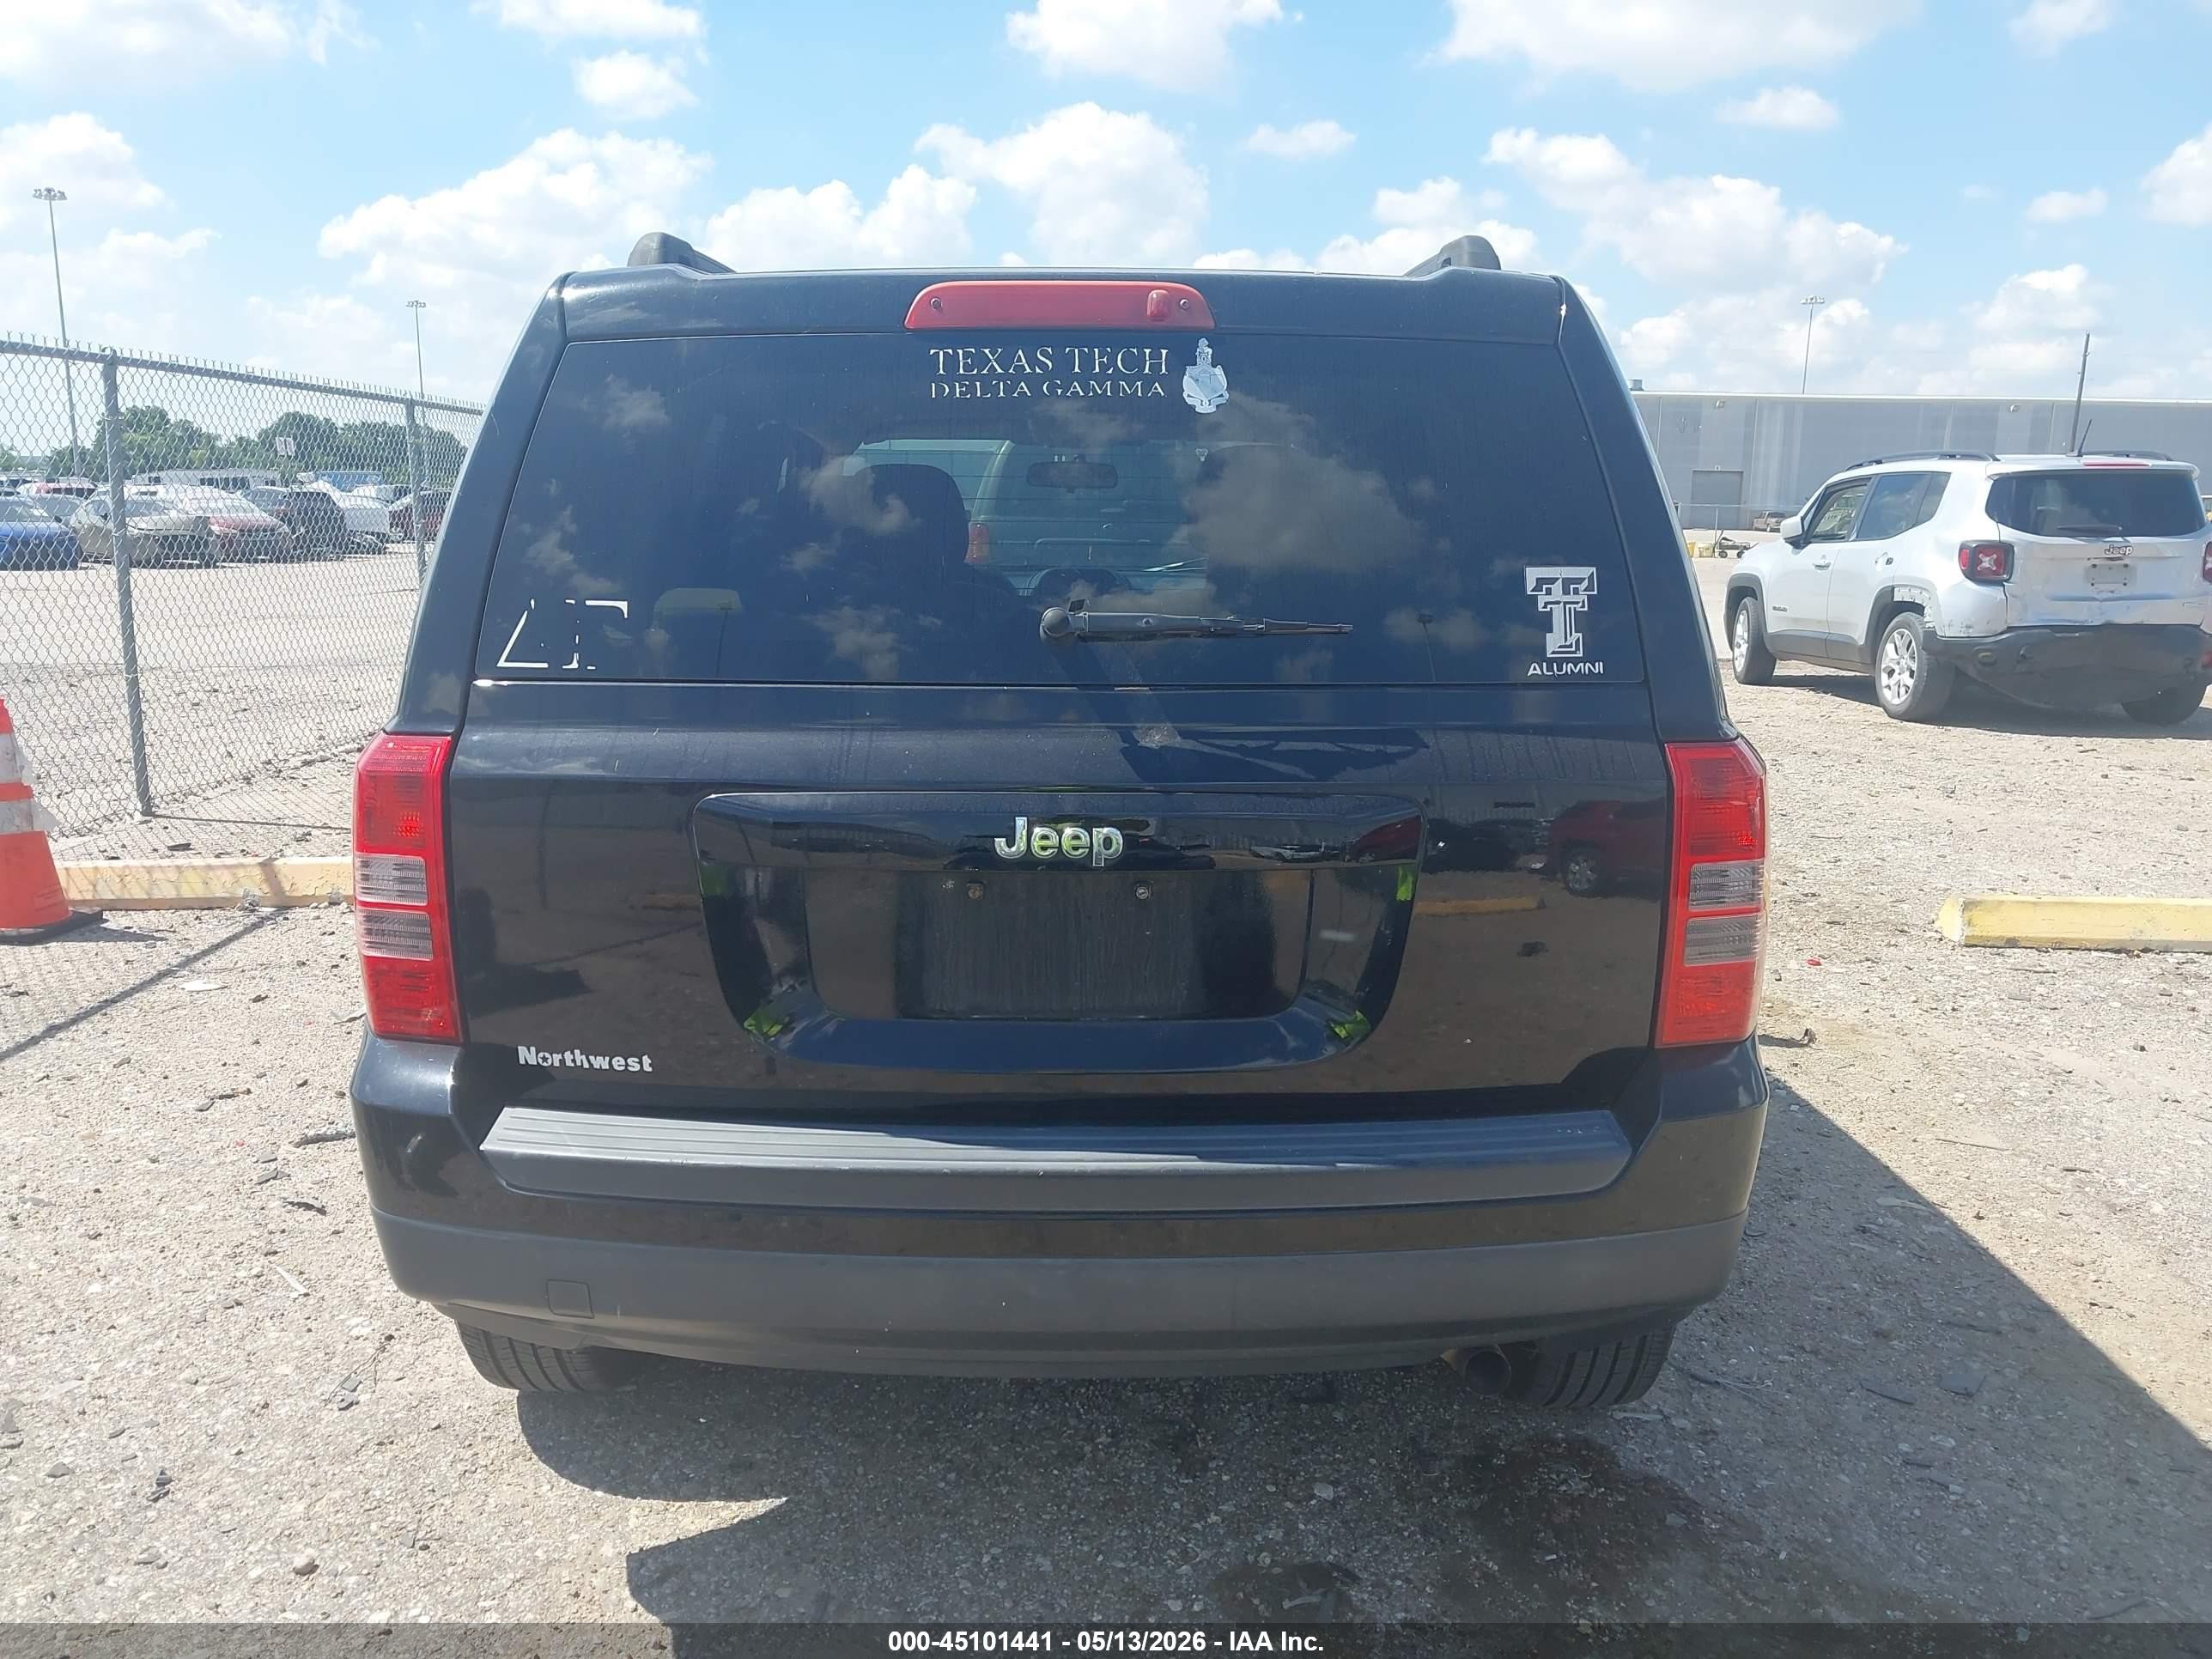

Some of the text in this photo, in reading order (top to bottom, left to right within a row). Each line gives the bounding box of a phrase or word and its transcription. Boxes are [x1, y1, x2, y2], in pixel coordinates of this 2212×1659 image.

[929, 347, 1170, 375] TEXAS TECH
[931, 380, 1168, 399] DELTA GAMMA
[2104, 544, 2134, 556] Jeep
[1527, 661, 1604, 677] ALUMNI
[994, 817, 1124, 867] Jeep
[517, 1045, 653, 1073] Northwest
